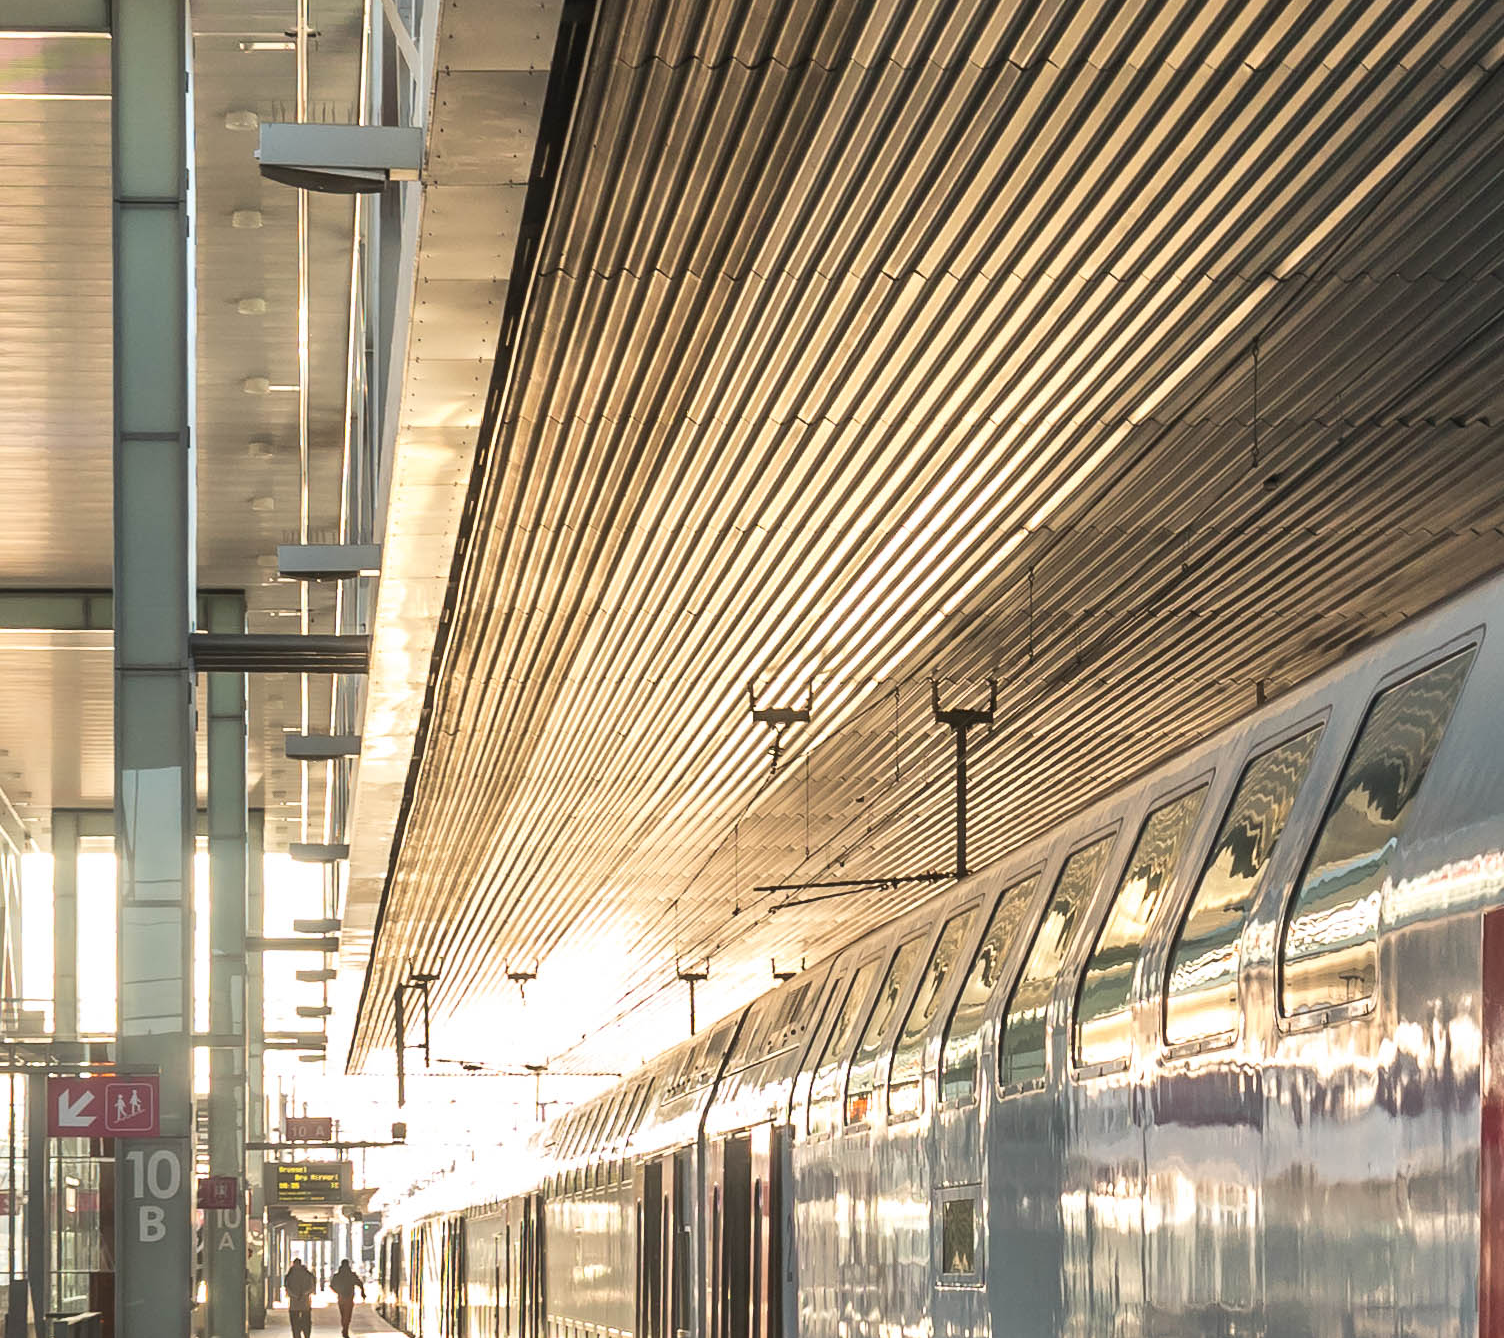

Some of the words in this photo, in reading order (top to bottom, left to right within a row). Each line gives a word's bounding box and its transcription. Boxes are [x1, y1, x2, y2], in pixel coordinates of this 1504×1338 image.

[126, 1149, 181, 1199] 10
[139, 1205, 166, 1242] B
[218, 1231, 235, 1251] A
